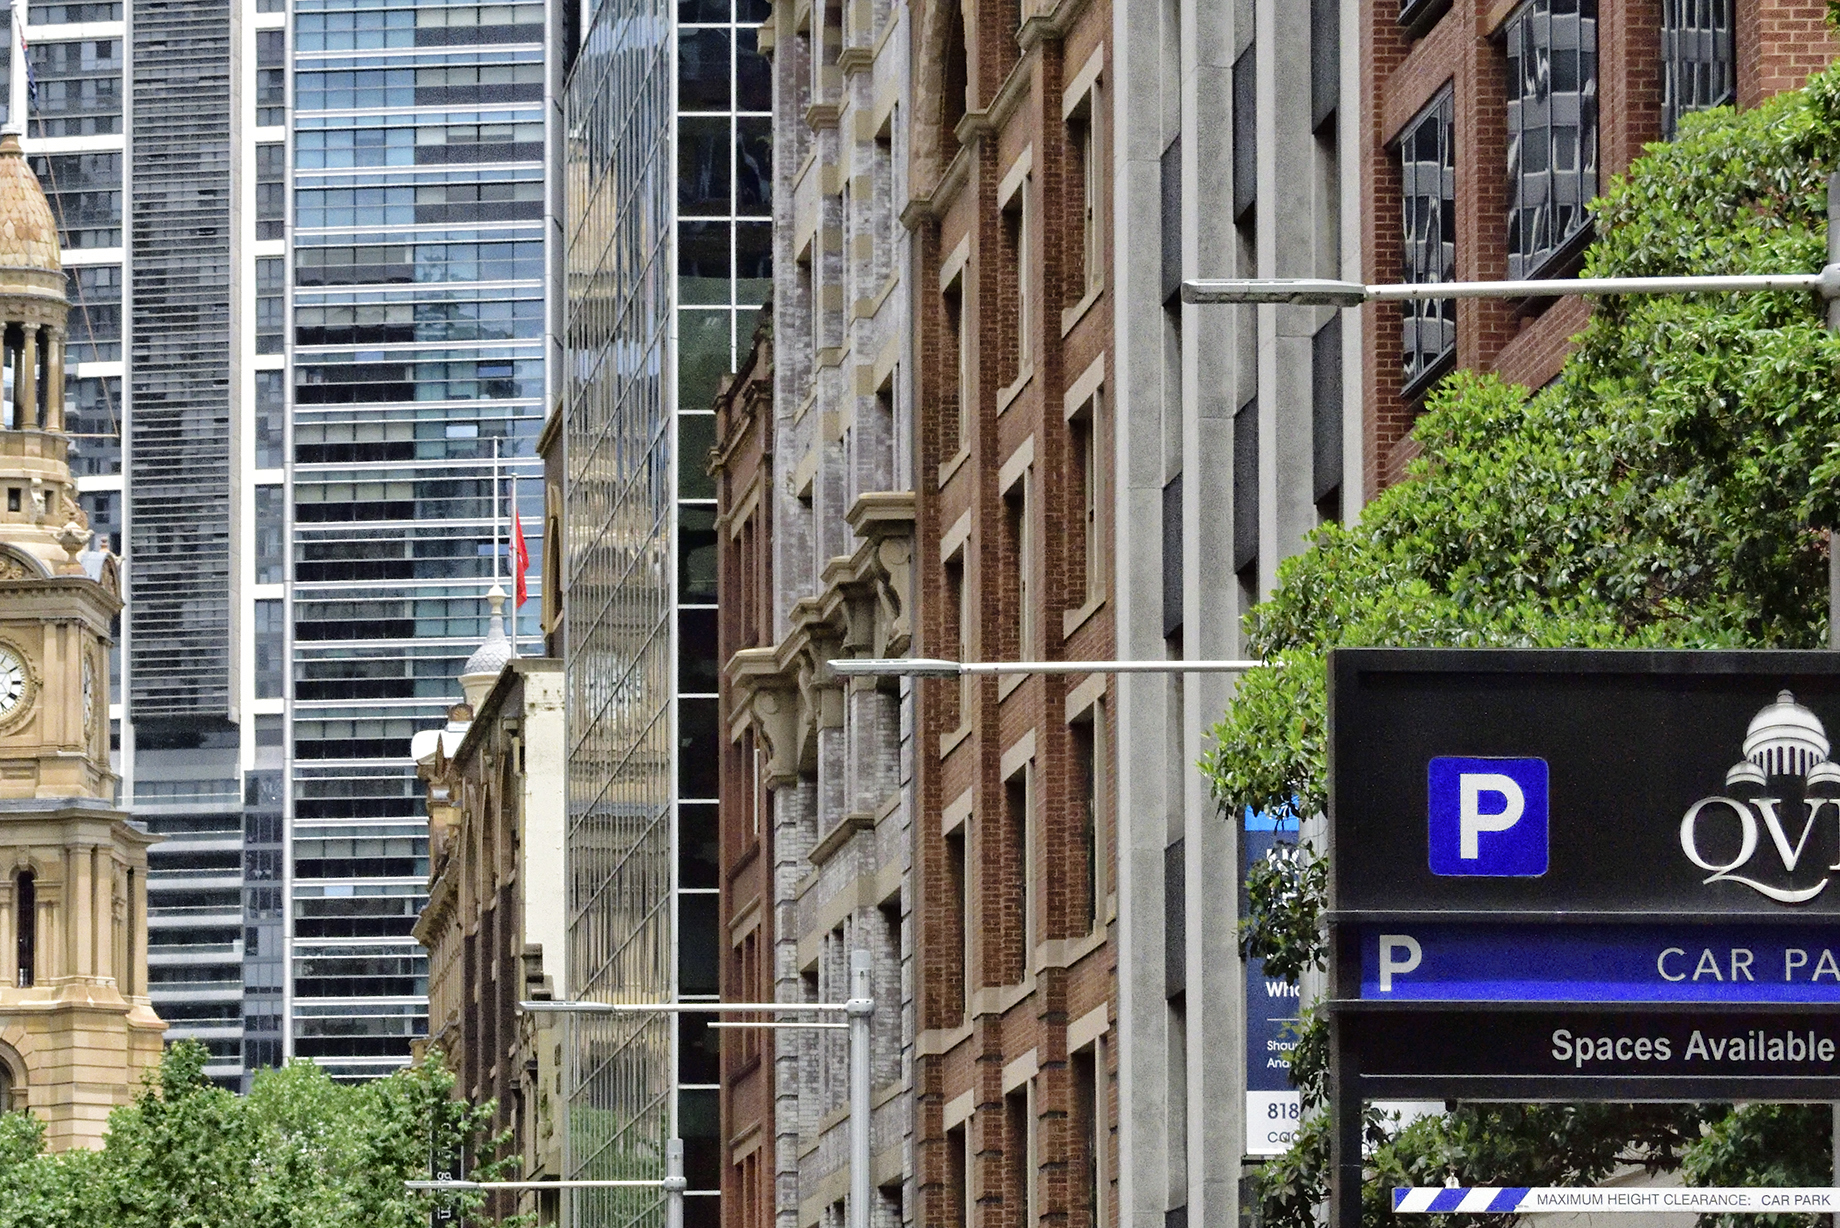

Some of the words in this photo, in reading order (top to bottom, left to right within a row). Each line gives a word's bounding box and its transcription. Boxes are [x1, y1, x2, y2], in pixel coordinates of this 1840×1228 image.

[1459, 773, 1525, 859] P
[1680, 796, 1840, 902] QV
[1379, 934, 1422, 991] P
[1657, 947, 1754, 981] CAR
[1785, 948, 1840, 981] PA
[1551, 1029, 1671, 1070] Spaces
[1684, 1030, 1835, 1062] Available
[1537, 1193, 1603, 1206] MAXIMUM
[1607, 1193, 1659, 1206] HEIGHT
[1664, 1193, 1752, 1206] CLEARANCE:
[1761, 1194, 1790, 1206] CAR
[1794, 1194, 1831, 1206] PARK
